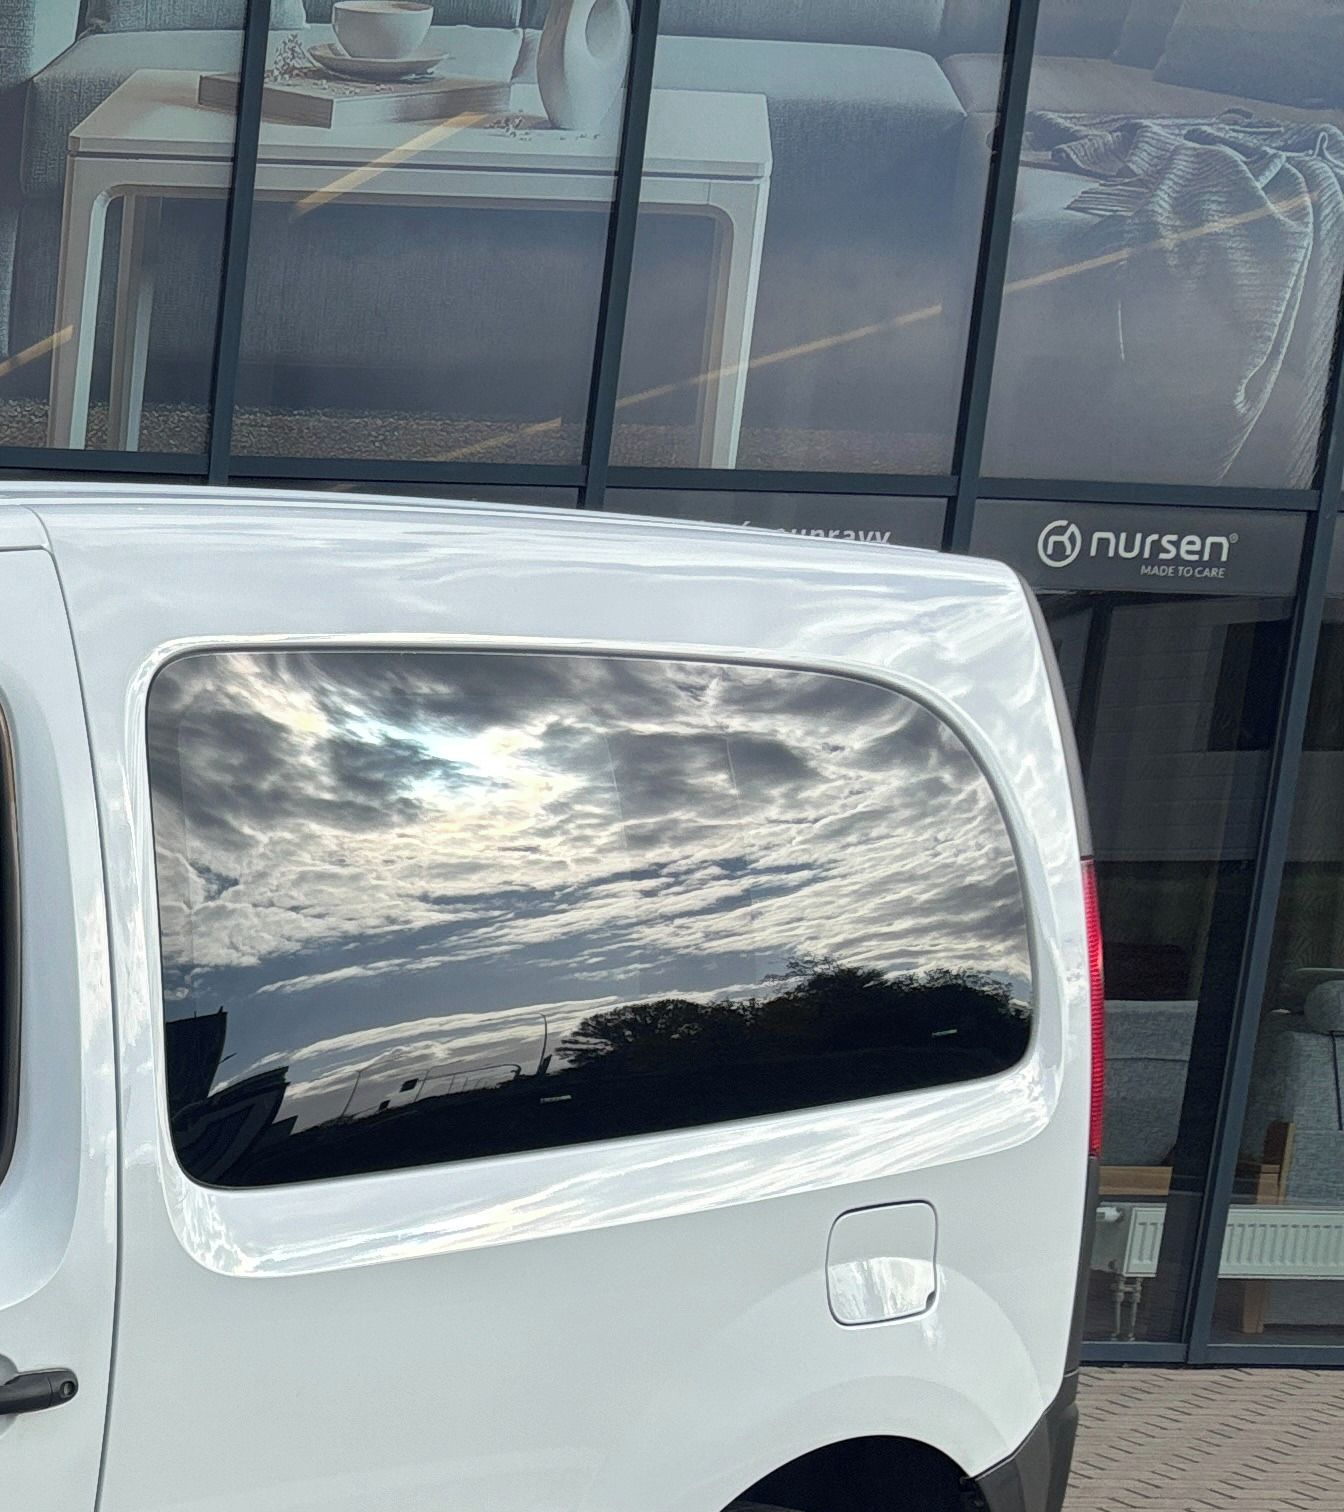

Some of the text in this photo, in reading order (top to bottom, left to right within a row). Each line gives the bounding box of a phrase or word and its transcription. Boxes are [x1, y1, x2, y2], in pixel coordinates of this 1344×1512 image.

[1140, 564, 1226, 579] MADE TO CARE
